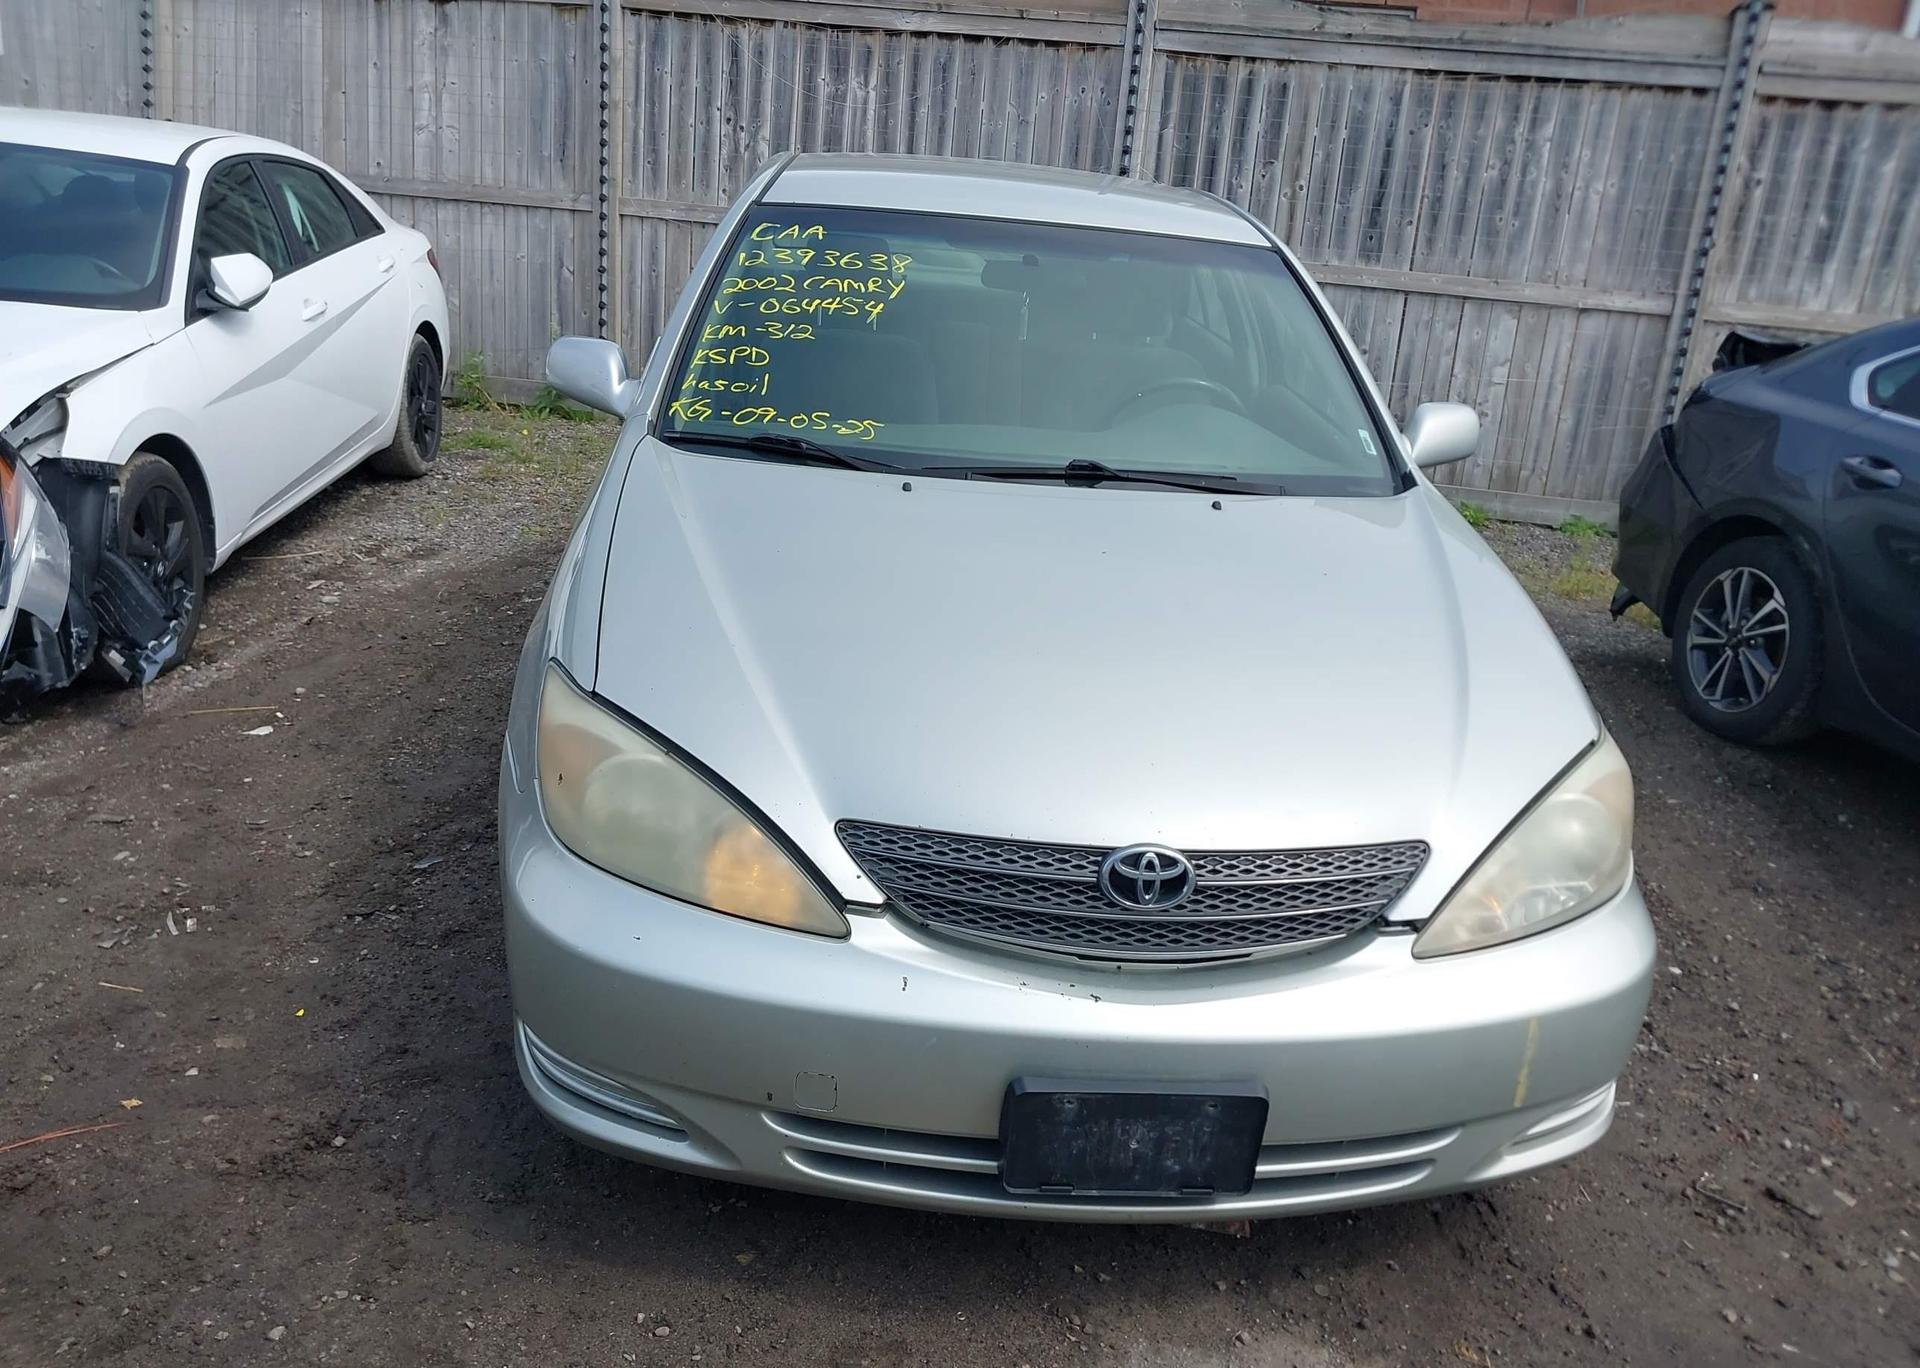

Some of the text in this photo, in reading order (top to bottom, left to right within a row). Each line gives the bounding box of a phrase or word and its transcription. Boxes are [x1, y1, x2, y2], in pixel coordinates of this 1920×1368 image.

[750, 223, 828, 241] CAA
[738, 248, 914, 273] 12393638
[723, 275, 906, 300] 2002 CAMRY
